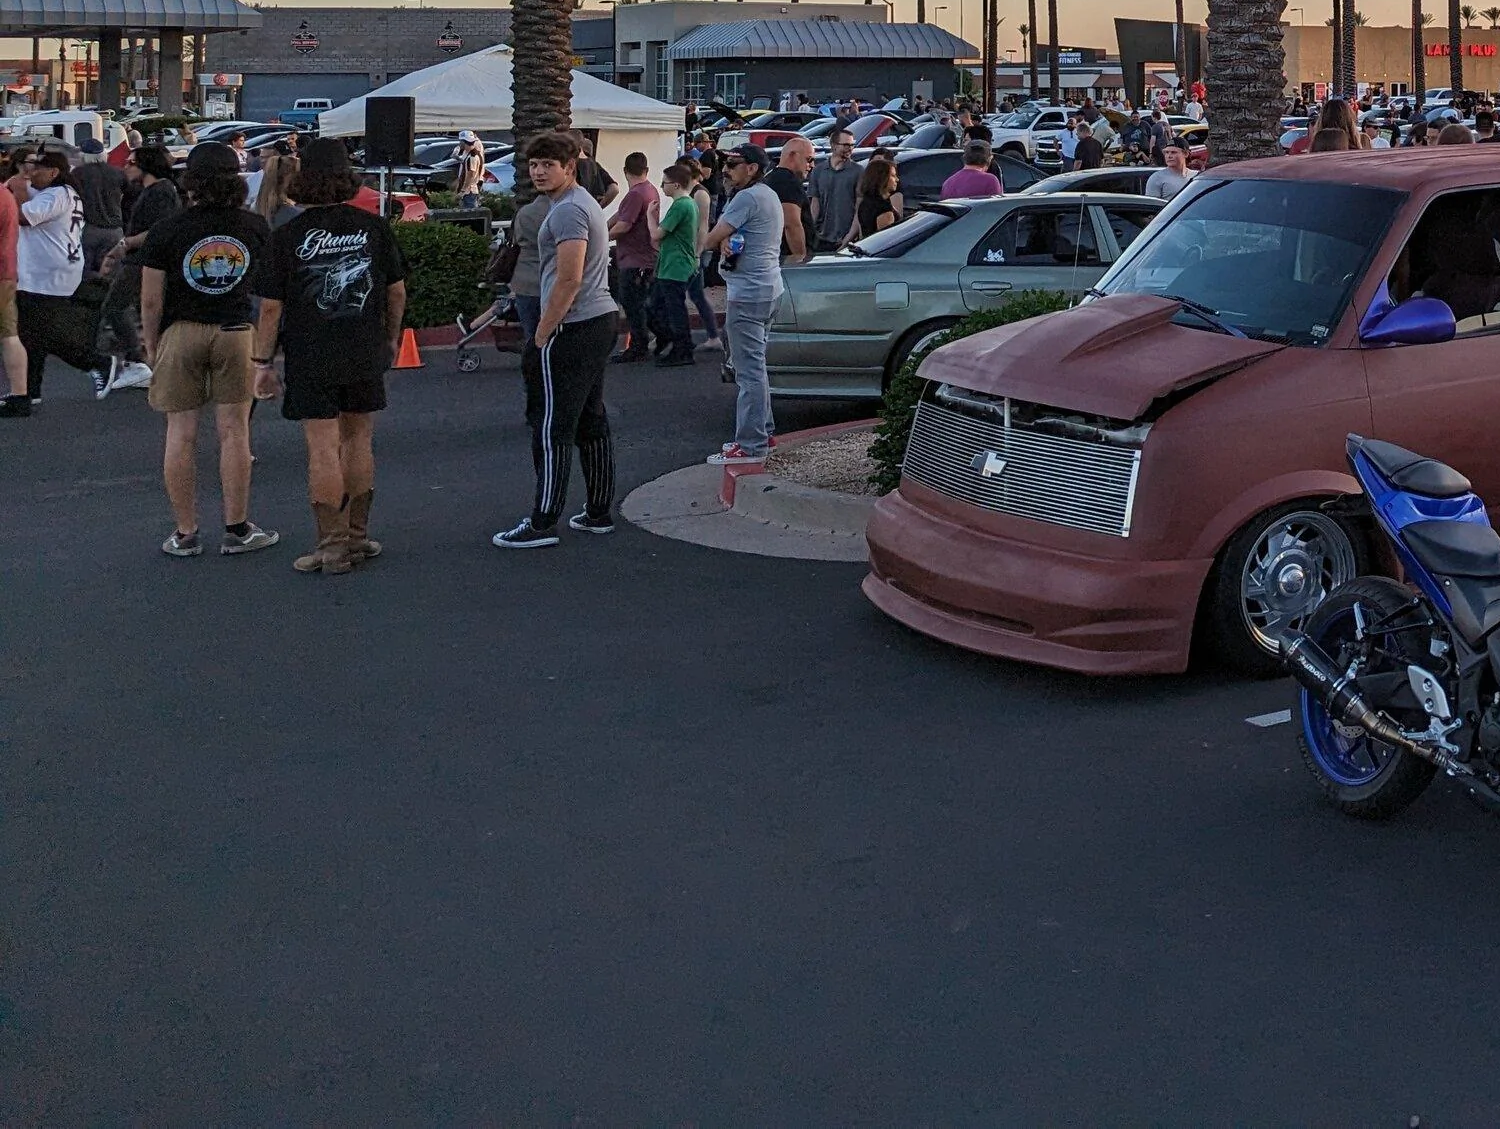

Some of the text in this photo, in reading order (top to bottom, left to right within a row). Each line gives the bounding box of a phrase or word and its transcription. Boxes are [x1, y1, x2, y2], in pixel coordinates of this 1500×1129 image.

[1426, 43, 1498, 57] LAMS PLUS
[295, 228, 369, 261] Glamis
[318, 244, 363, 255] SPEED SHOP
